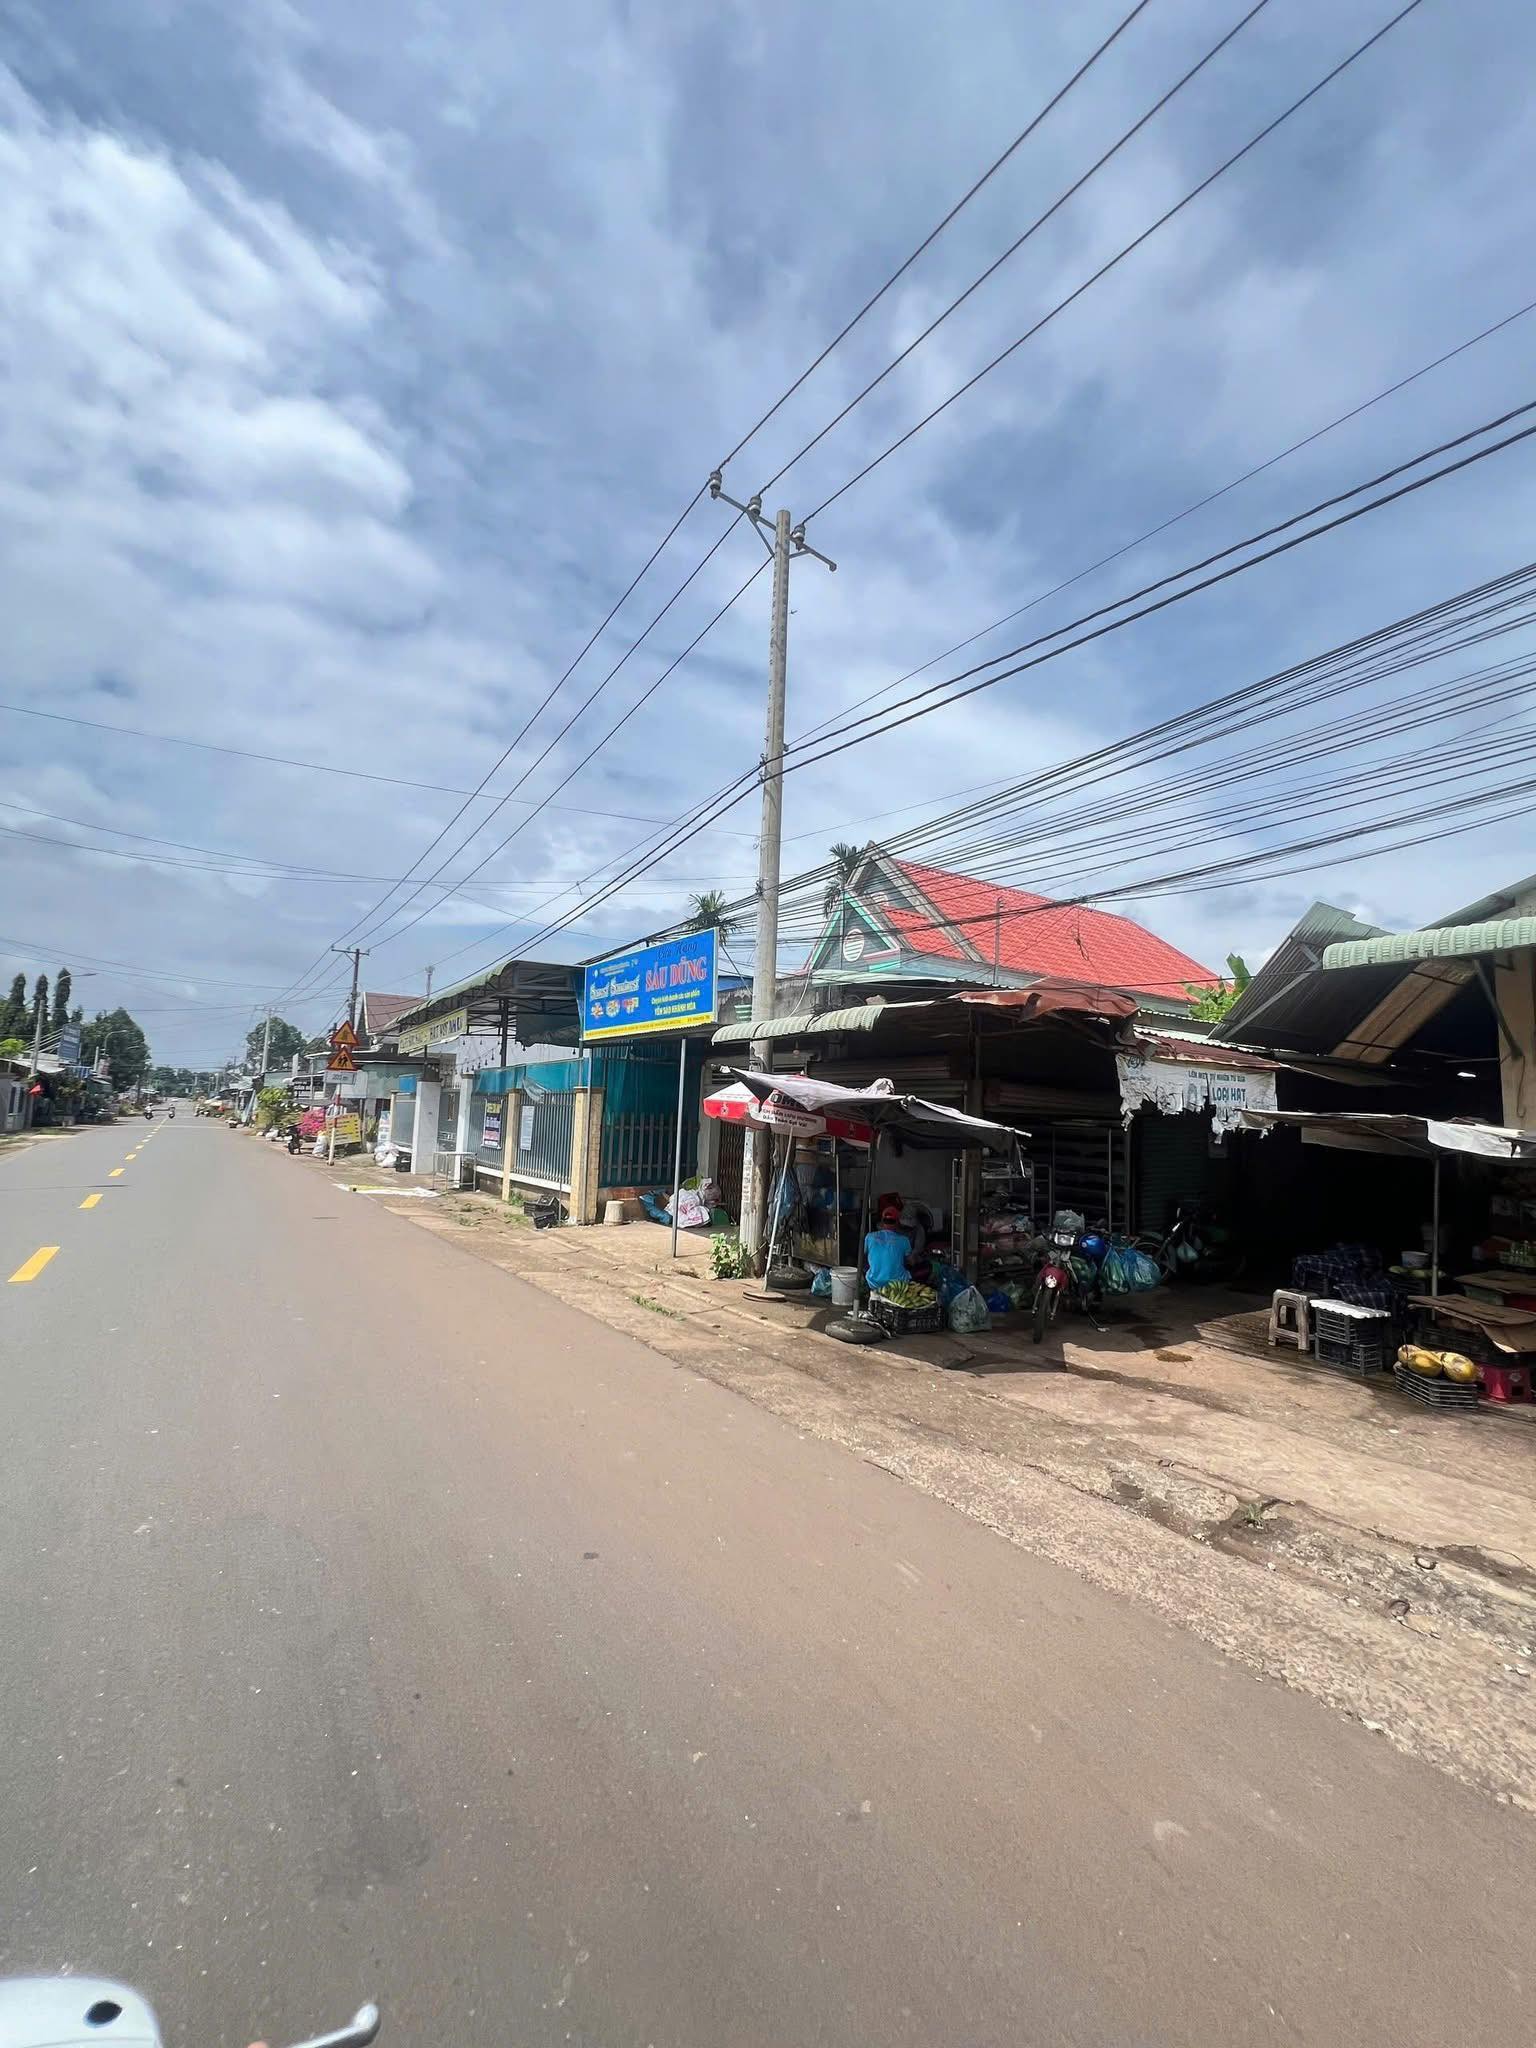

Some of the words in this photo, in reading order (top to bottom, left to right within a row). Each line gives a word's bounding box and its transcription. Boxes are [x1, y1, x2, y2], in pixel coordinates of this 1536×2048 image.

[646, 962, 668, 993] SÁU
[670, 956, 707, 986] DŨNG
[1212, 1087, 1230, 1103] LOẠI
[1231, 1088, 1246, 1103] HẠT
